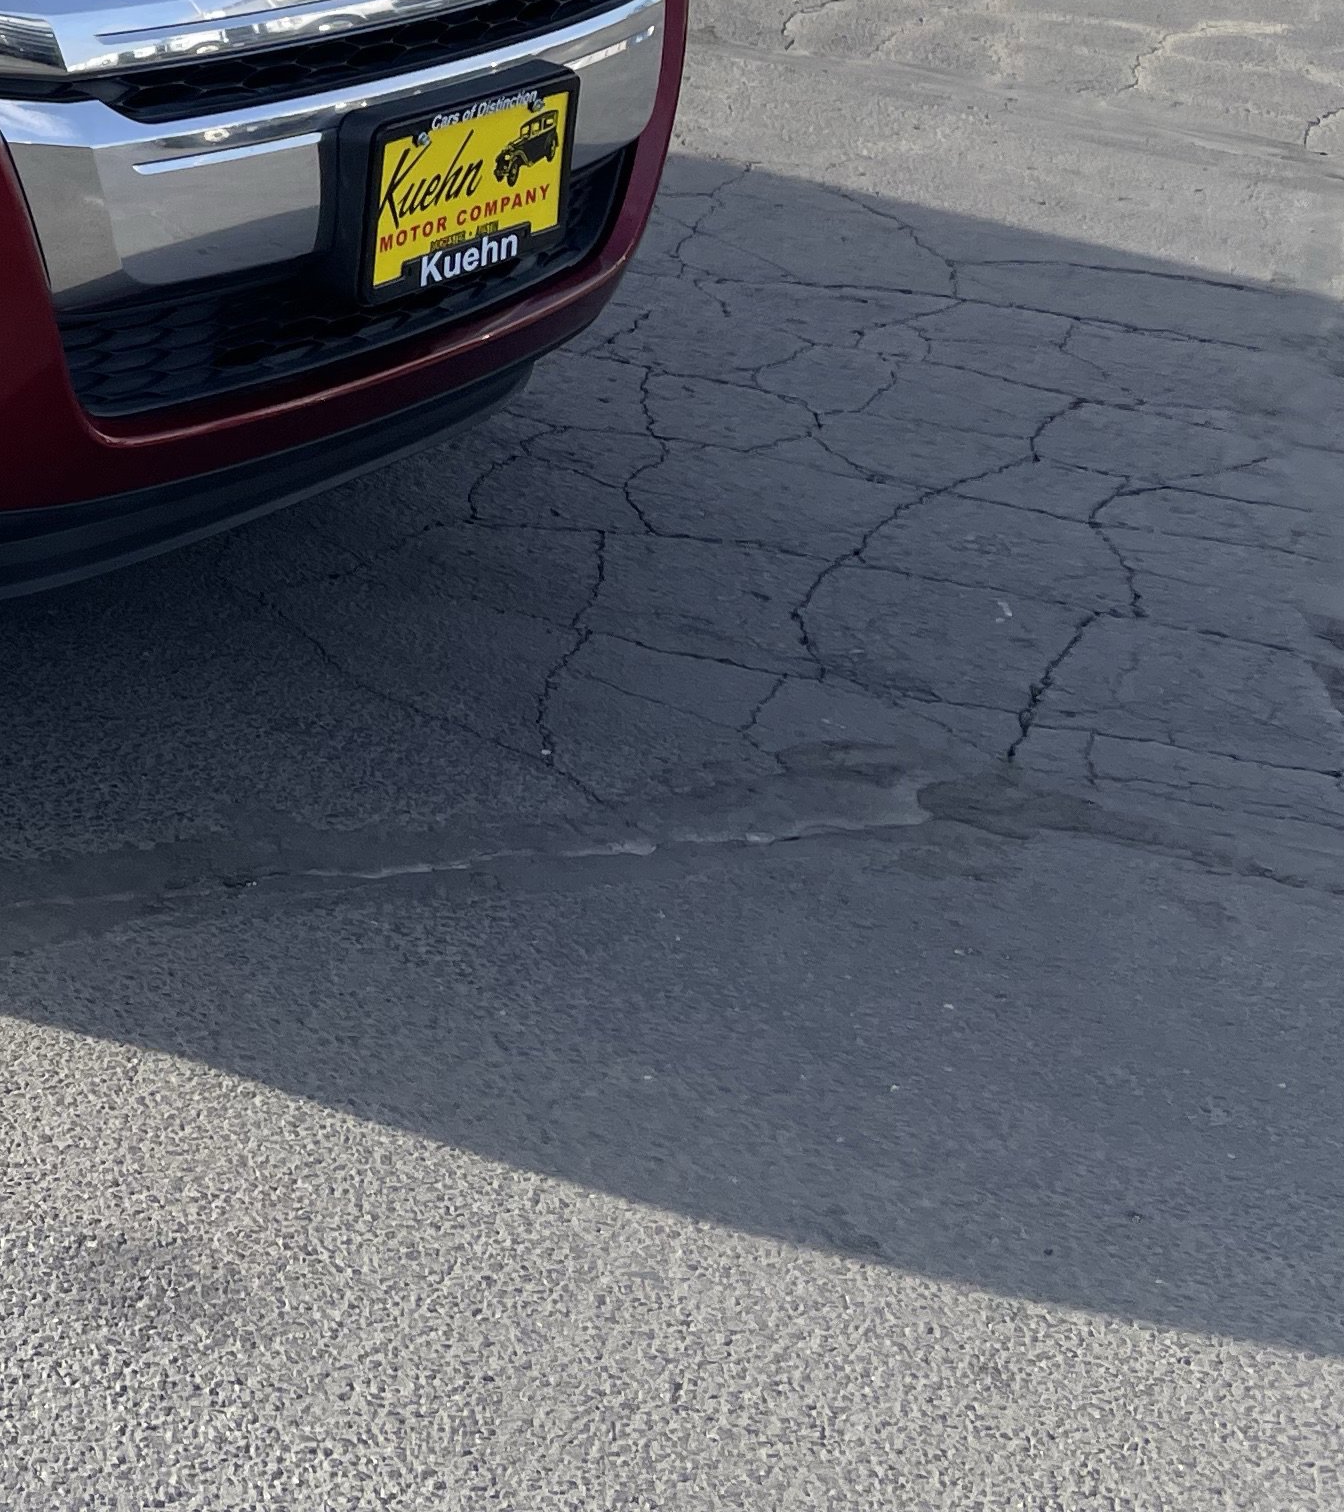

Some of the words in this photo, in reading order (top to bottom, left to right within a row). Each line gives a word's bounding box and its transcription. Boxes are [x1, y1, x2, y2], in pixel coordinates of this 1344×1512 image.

[431, 112, 461, 131] Cars
[462, 103, 478, 123] of
[476, 90, 539, 120] Distinction
[378, 129, 483, 229] Kuehn
[379, 215, 448, 254] MOTOR
[456, 183, 551, 227] COMPANY
[419, 233, 519, 288] Kuehn
